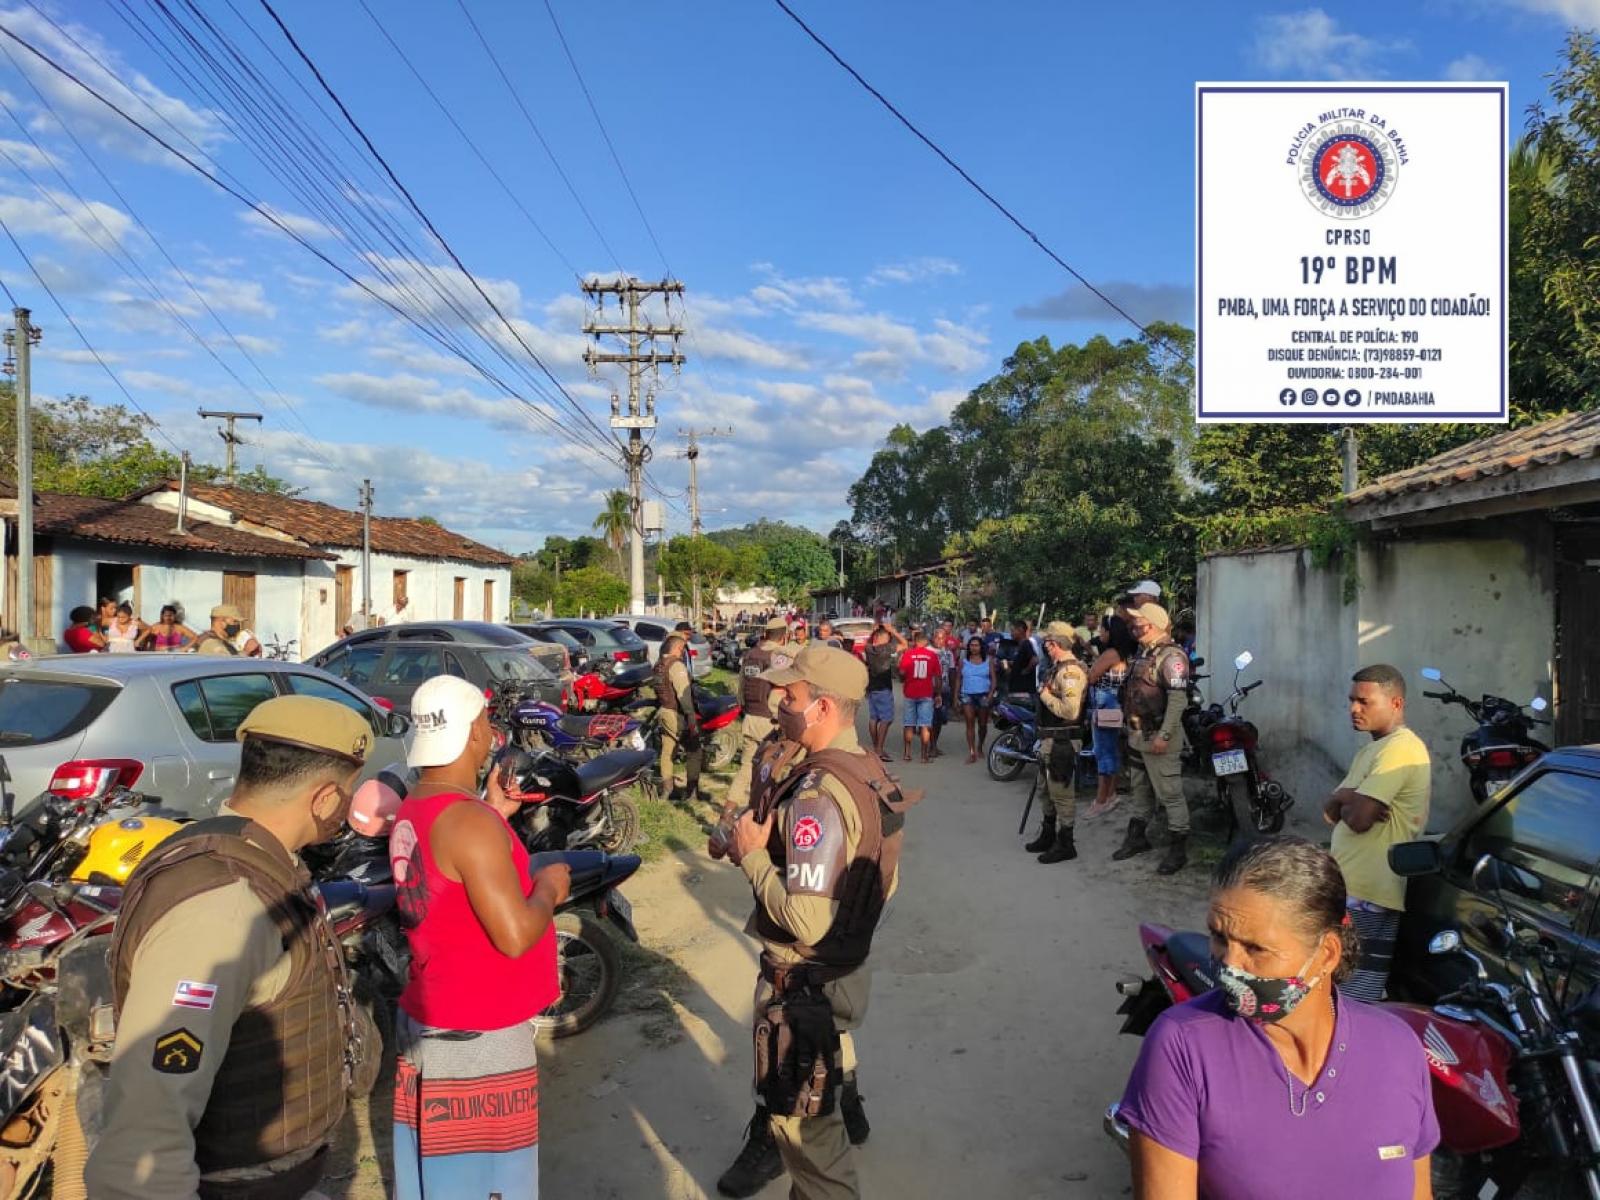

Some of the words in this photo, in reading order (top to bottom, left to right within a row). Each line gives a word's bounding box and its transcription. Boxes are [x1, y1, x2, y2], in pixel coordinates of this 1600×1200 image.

[913, 660, 928, 679] 10
[798, 834, 813, 847] 19
[787, 862, 825, 892] PM
[450, 1087, 531, 1121] QUIKSILVER
